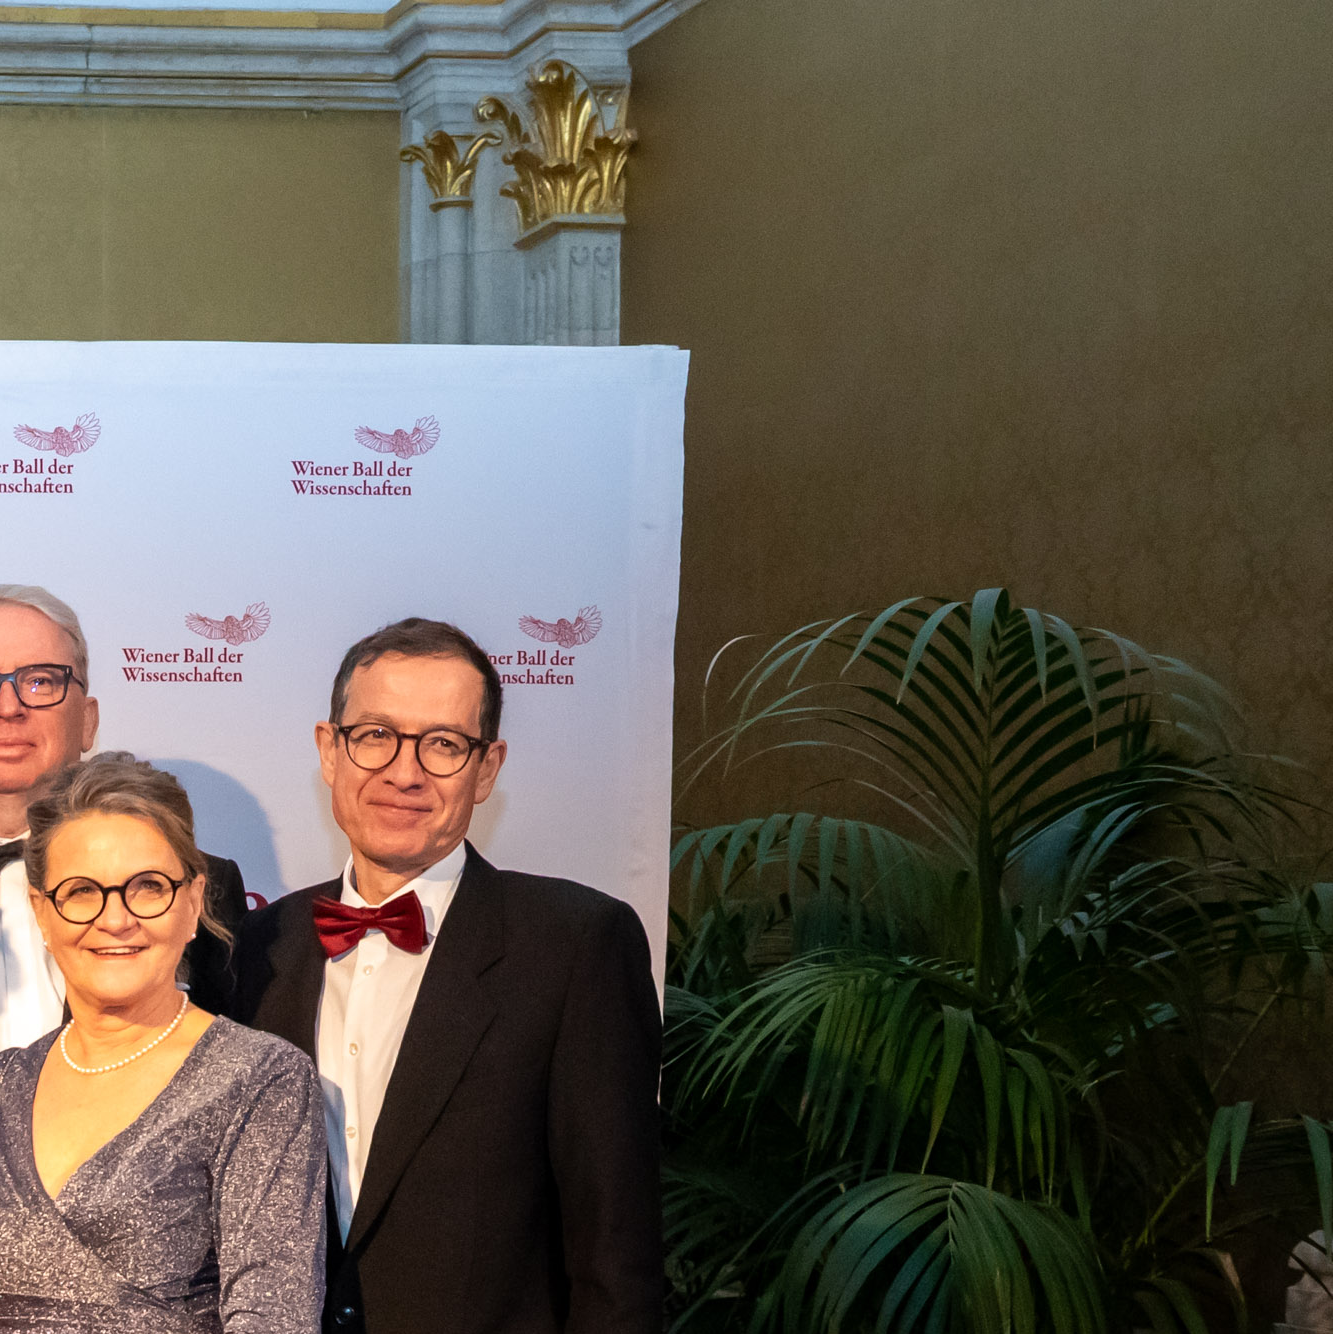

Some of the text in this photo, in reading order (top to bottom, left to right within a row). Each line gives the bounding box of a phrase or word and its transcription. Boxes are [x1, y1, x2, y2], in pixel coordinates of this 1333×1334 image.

[14, 458, 43, 474] Ball
[48, 458, 74, 474] der
[292, 461, 413, 476] Wiener Ball der
[292, 480, 413, 496] Wissenschaften
[122, 648, 243, 663] Wiener Ball der
[488, 650, 575, 665] ner Ball der
[122, 666, 243, 682] Wissenschaften
[500, 669, 575, 684] nschaften
